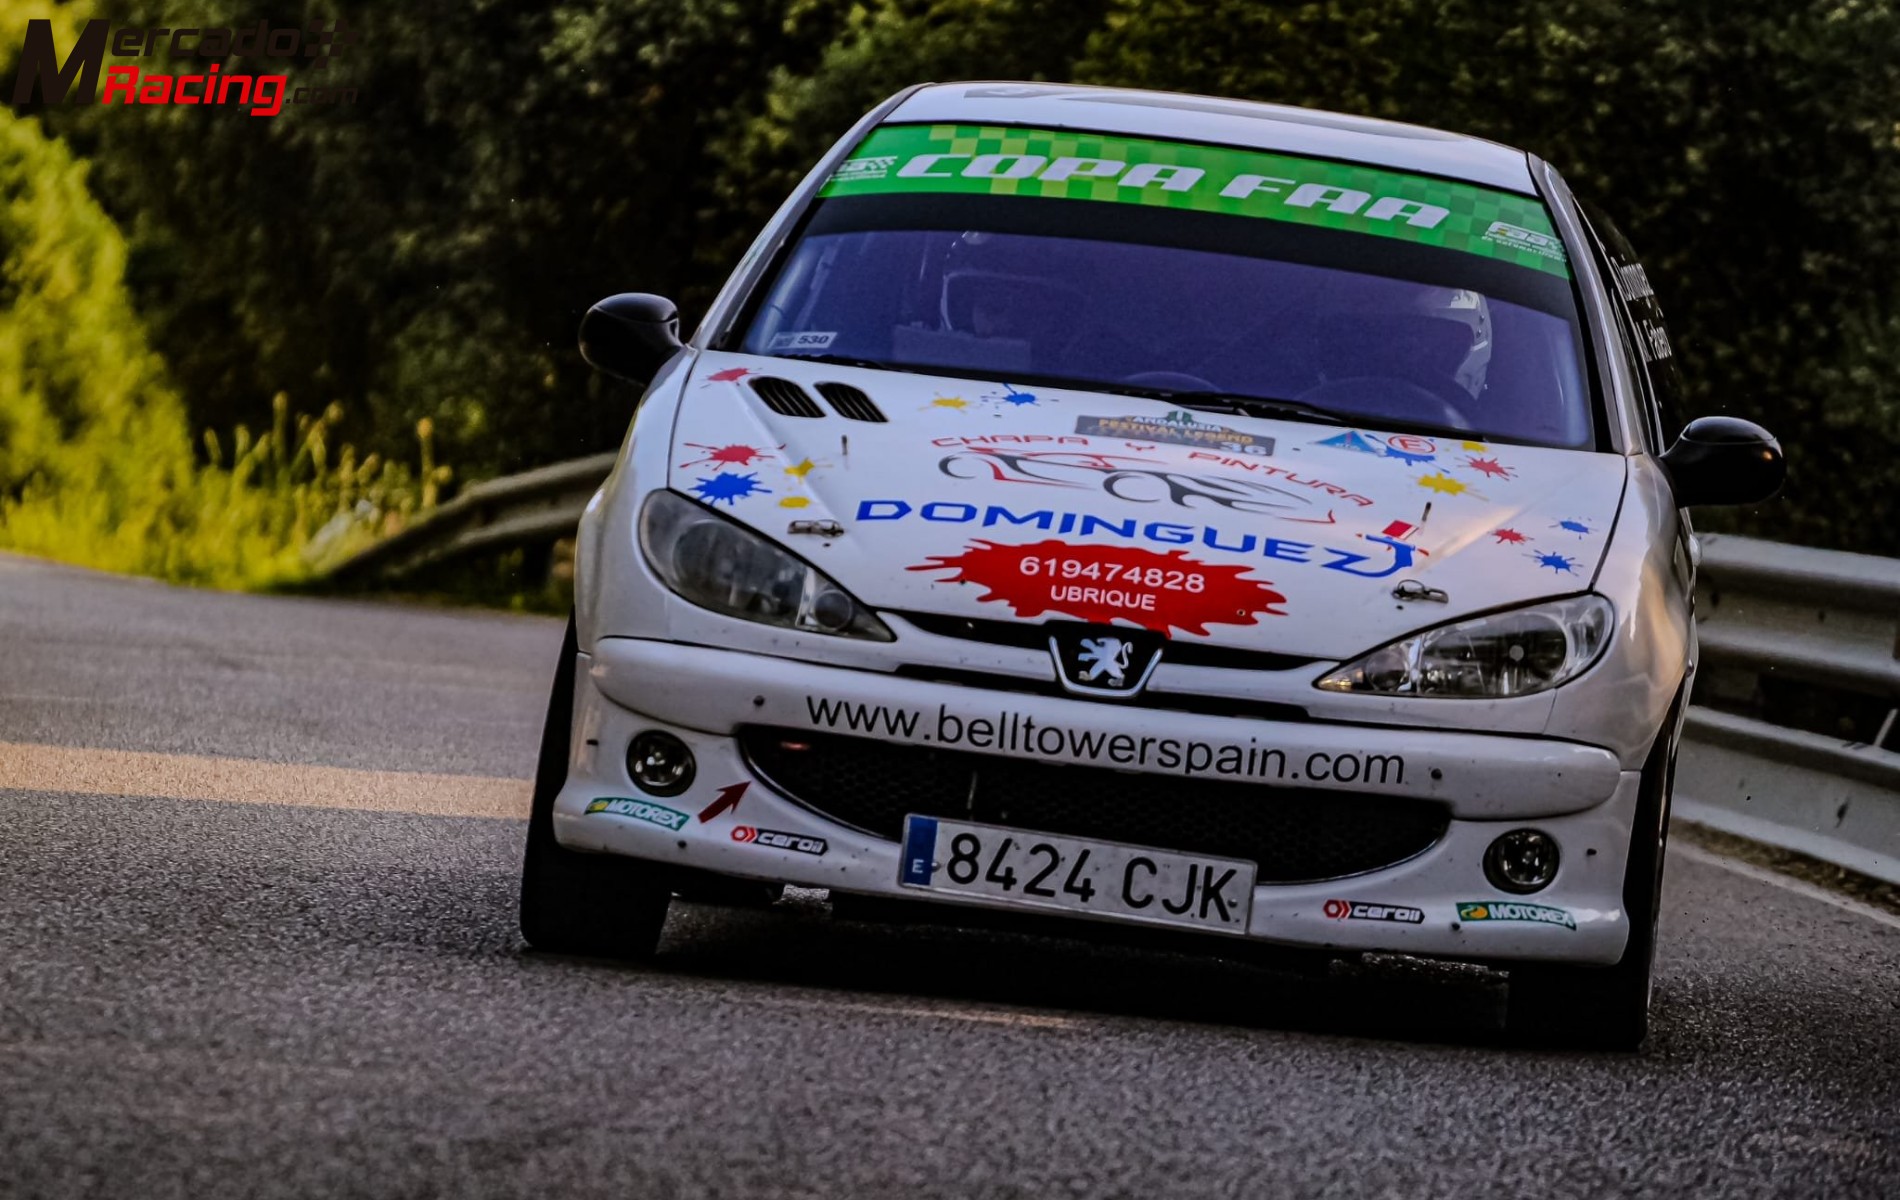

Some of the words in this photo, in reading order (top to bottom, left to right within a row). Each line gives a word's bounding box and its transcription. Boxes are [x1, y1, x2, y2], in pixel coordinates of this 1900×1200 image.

[897, 154, 1206, 192] COPA
[1219, 174, 1450, 229] FAA
[797, 335, 829, 345] 530
[931, 434, 1089, 447] CHAPA
[1125, 442, 1155, 451] Y
[1188, 452, 1374, 507] PINTURA
[856, 500, 1415, 578] DOMINGUEZ
[1019, 556, 1206, 593] 619474828
[1050, 584, 1157, 611] UBRIQUE
[807, 695, 1405, 785] www.belltowerspain.com
[605, 799, 685, 828] MOTOREX
[911, 858, 924, 874] E
[946, 833, 1096, 903] 8424
[1121, 857, 1238, 922] CJK
[1488, 903, 1576, 927] MOTOREX
